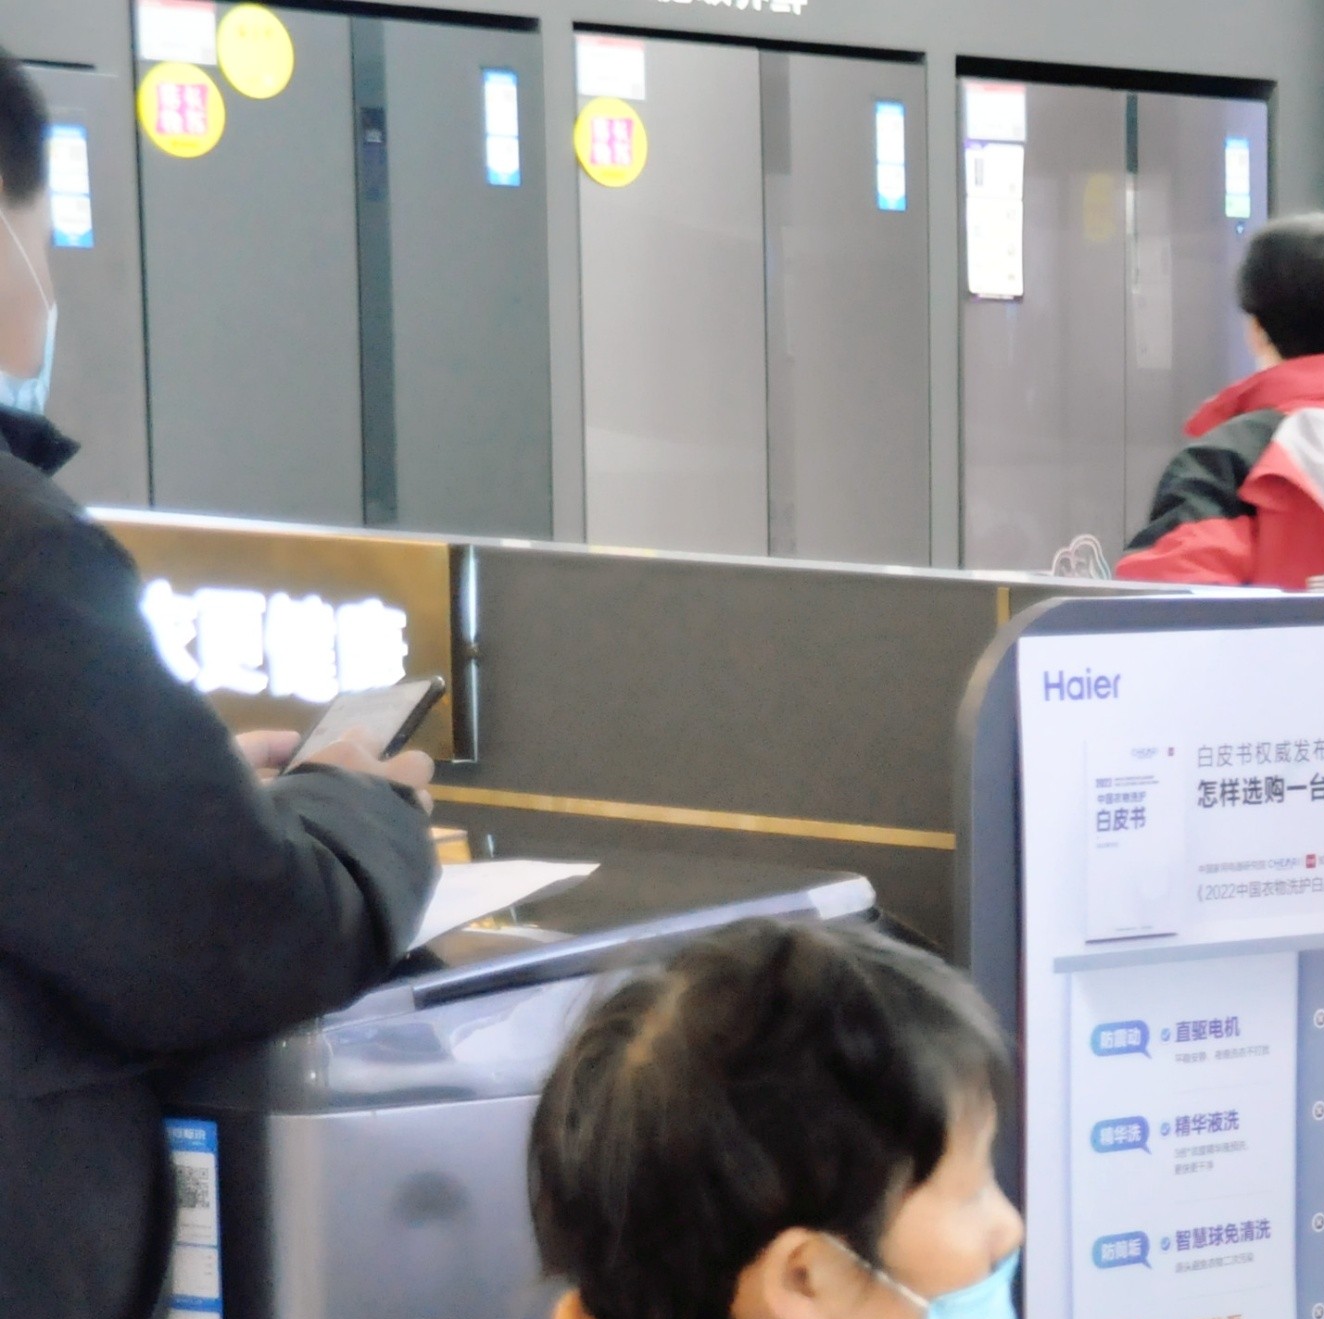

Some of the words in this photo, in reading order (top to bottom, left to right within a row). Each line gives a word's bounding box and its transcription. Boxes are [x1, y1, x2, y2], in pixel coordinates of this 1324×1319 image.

[1043, 667, 1122, 702] Haier
[1096, 806, 1147, 833] 白皮书
[1175, 1015, 1241, 1043] 直驱电机
[1174, 1109, 1240, 1138] 精华液洗
[1175, 1217, 1272, 1252] 智慧球免清洗
